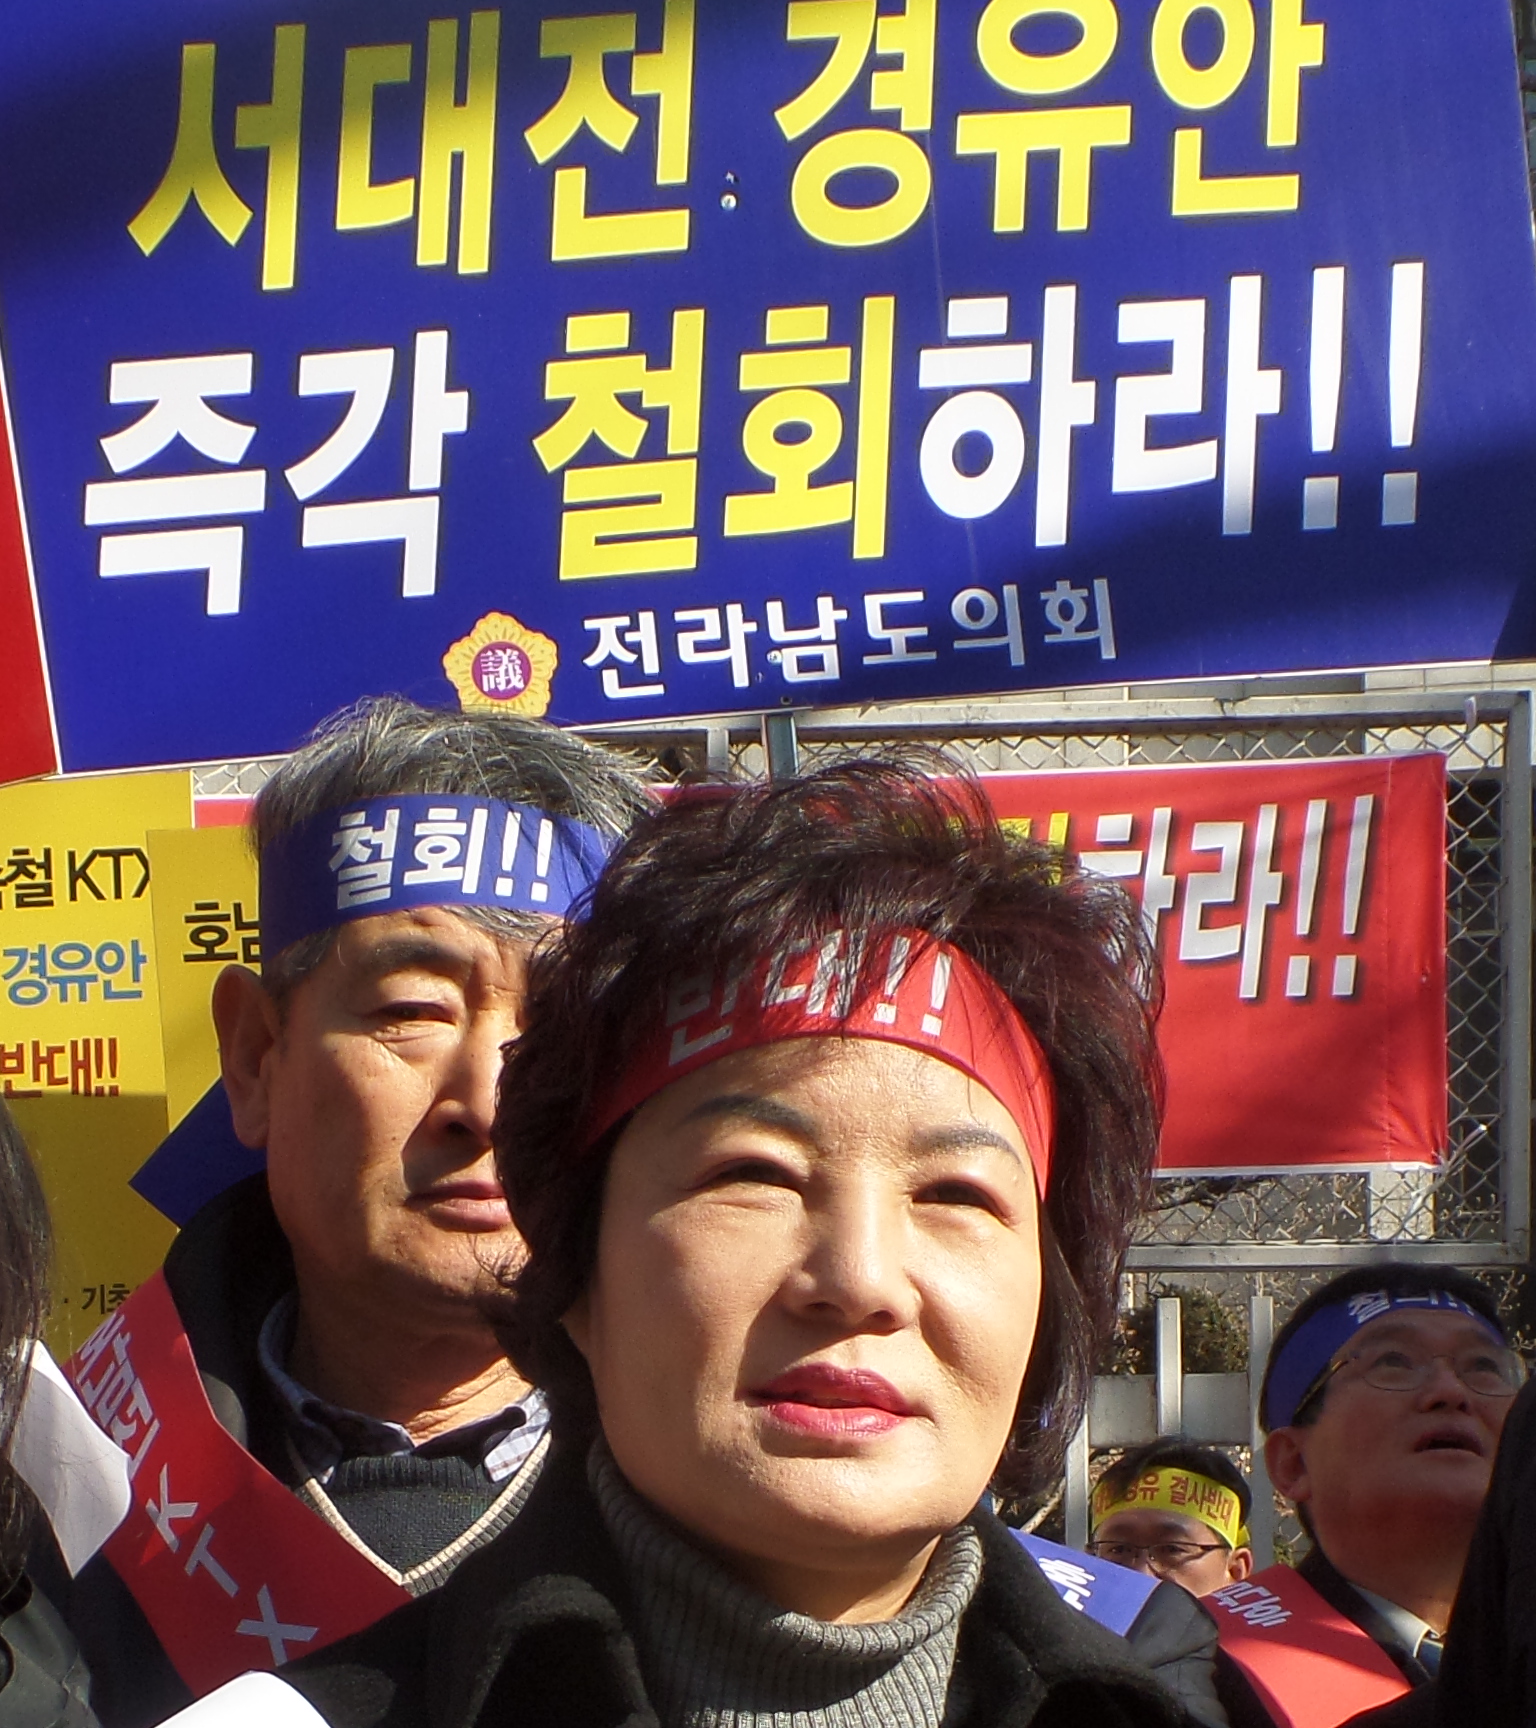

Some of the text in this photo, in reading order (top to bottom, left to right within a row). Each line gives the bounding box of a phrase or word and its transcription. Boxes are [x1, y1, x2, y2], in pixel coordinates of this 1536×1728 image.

[127, 0, 1325, 290] 서대전 경유안
[84, 330, 468, 615] 즉각
[532, 262, 1424, 581] 철회하라!!
[583, 578, 1116, 699] 전라남도의회
[328, 808, 553, 909] 철회!!
[3, 940, 147, 1006] 경유안
[144, 1463, 318, 1666] KTX
